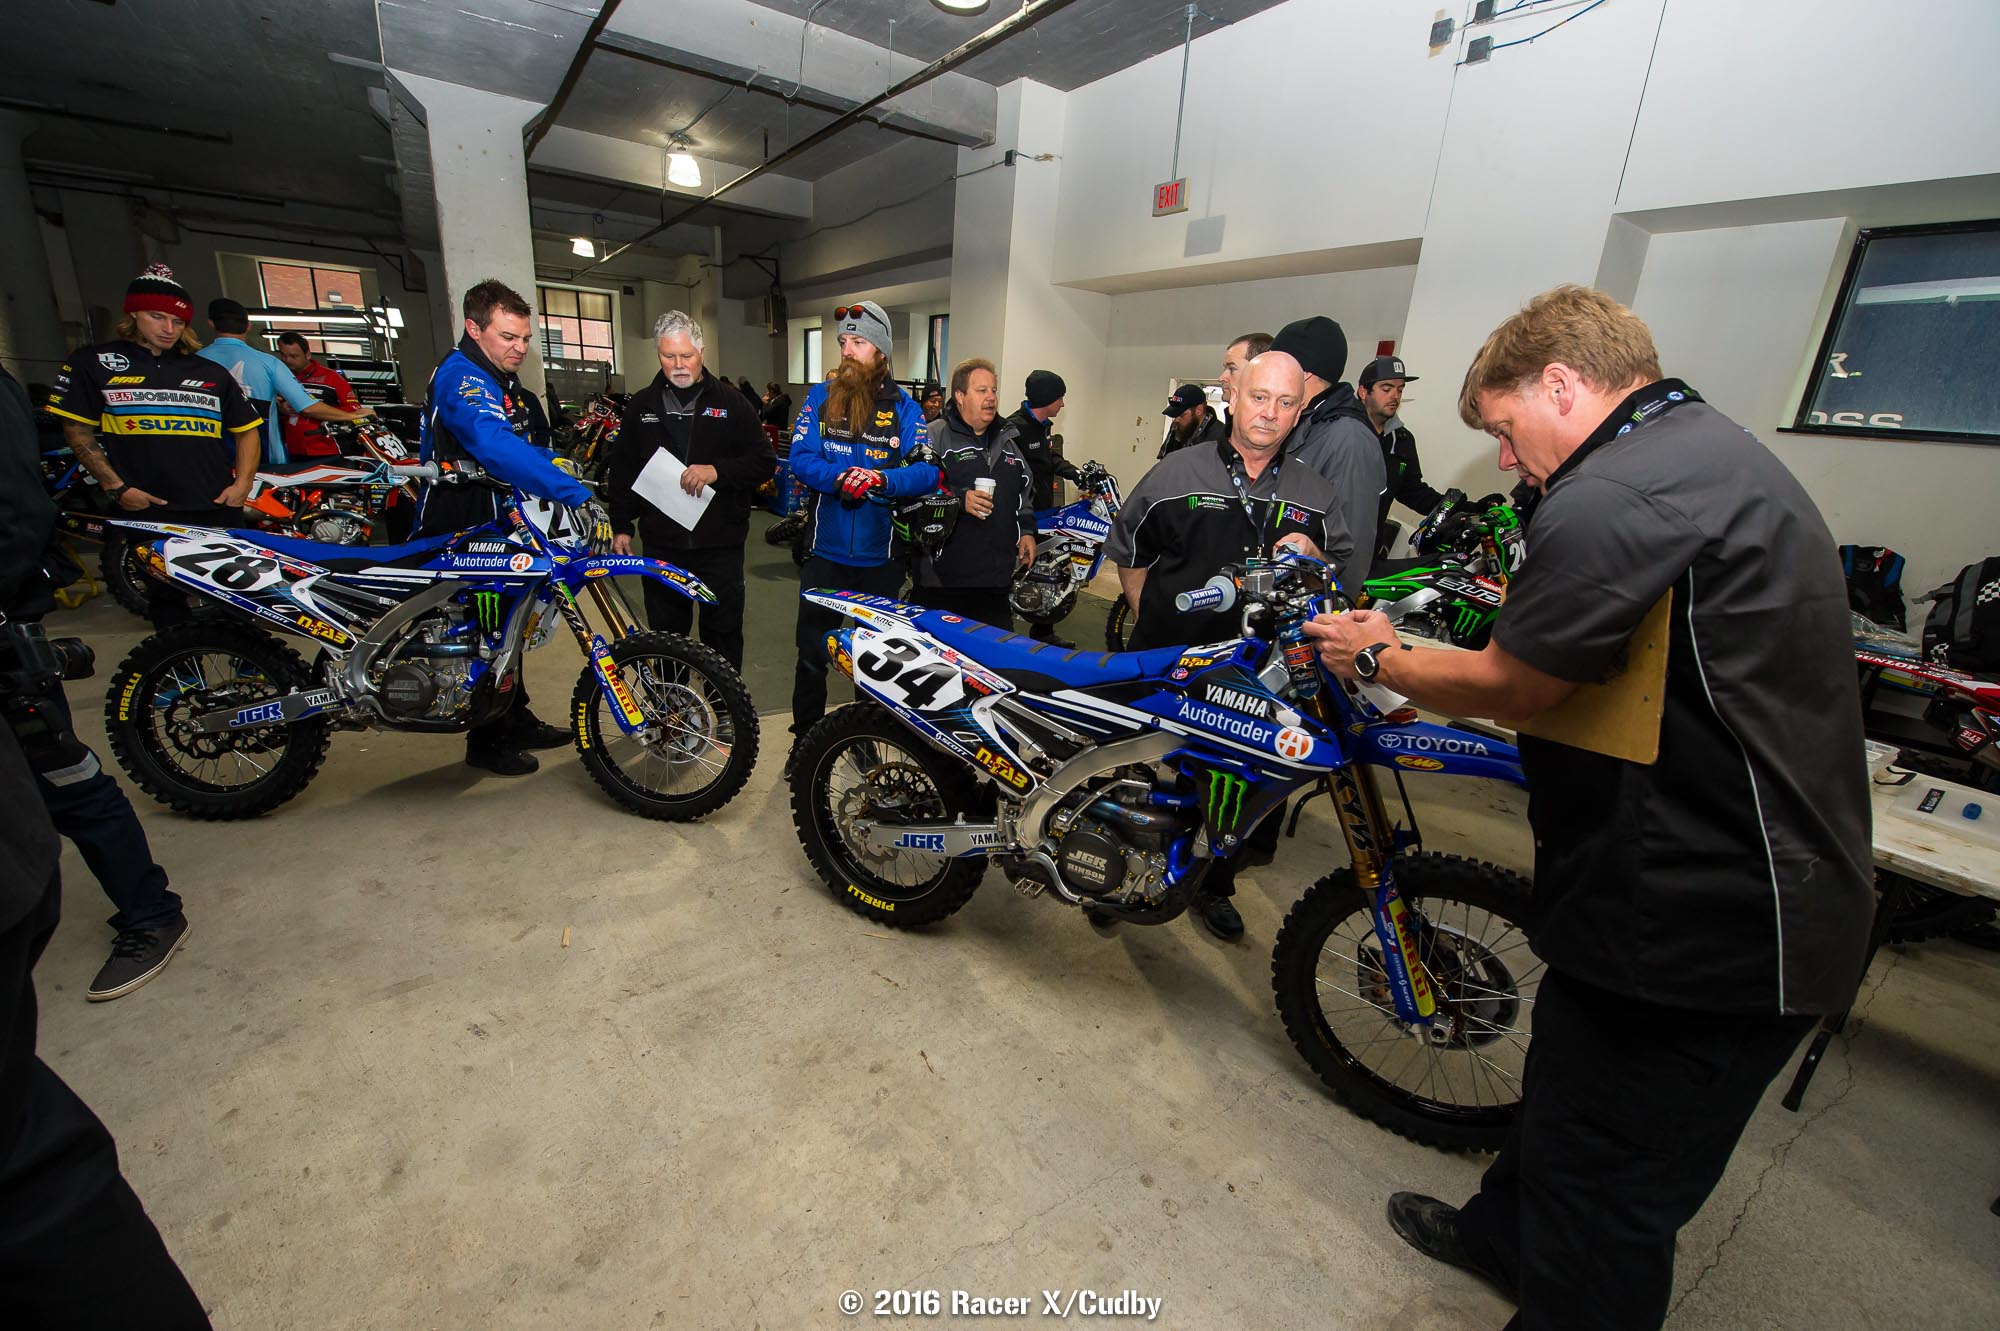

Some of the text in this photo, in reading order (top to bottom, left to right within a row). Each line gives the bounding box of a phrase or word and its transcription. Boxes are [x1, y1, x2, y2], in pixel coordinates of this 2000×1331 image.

[1158, 182, 1180, 209] EXIT
[107, 376, 146, 385] MAD
[133, 391, 216, 408] YOSHIMURA
[138, 418, 215, 434] SUZUKI
[862, 432, 889, 443] Autotrader
[829, 442, 853, 454] YAMAHA
[131, 521, 159, 531] TOYOTA
[1076, 518, 1110, 534] YAMAHA
[467, 542, 506, 553] YAMAHA
[169, 543, 279, 591] 28
[452, 555, 509, 567] Autotrader
[601, 558, 645, 567] TOYOTA
[1191, 586, 1221, 599] RENTHAL
[1475, 578, 1502, 592] Kawasak
[824, 599, 847, 613] TOYOTA
[1193, 595, 1221, 608] RENTHAL
[262, 610, 290, 624] SCOTT
[857, 637, 959, 709] 34
[964, 675, 993, 696] FRAM
[119, 672, 142, 721] PIRELLI
[1205, 683, 1268, 718] YAMAHA
[229, 702, 284, 728] JGR
[1178, 702, 1273, 744] Autotrader
[577, 702, 590, 750] PIRELLI
[940, 737, 969, 756] SCOTT
[1403, 735, 1489, 756] TOYOTA
[895, 833, 947, 850] JGR
[1068, 849, 1108, 868] JGR
[1067, 862, 1106, 881] HINSON
[848, 884, 895, 912] PIRELLI
